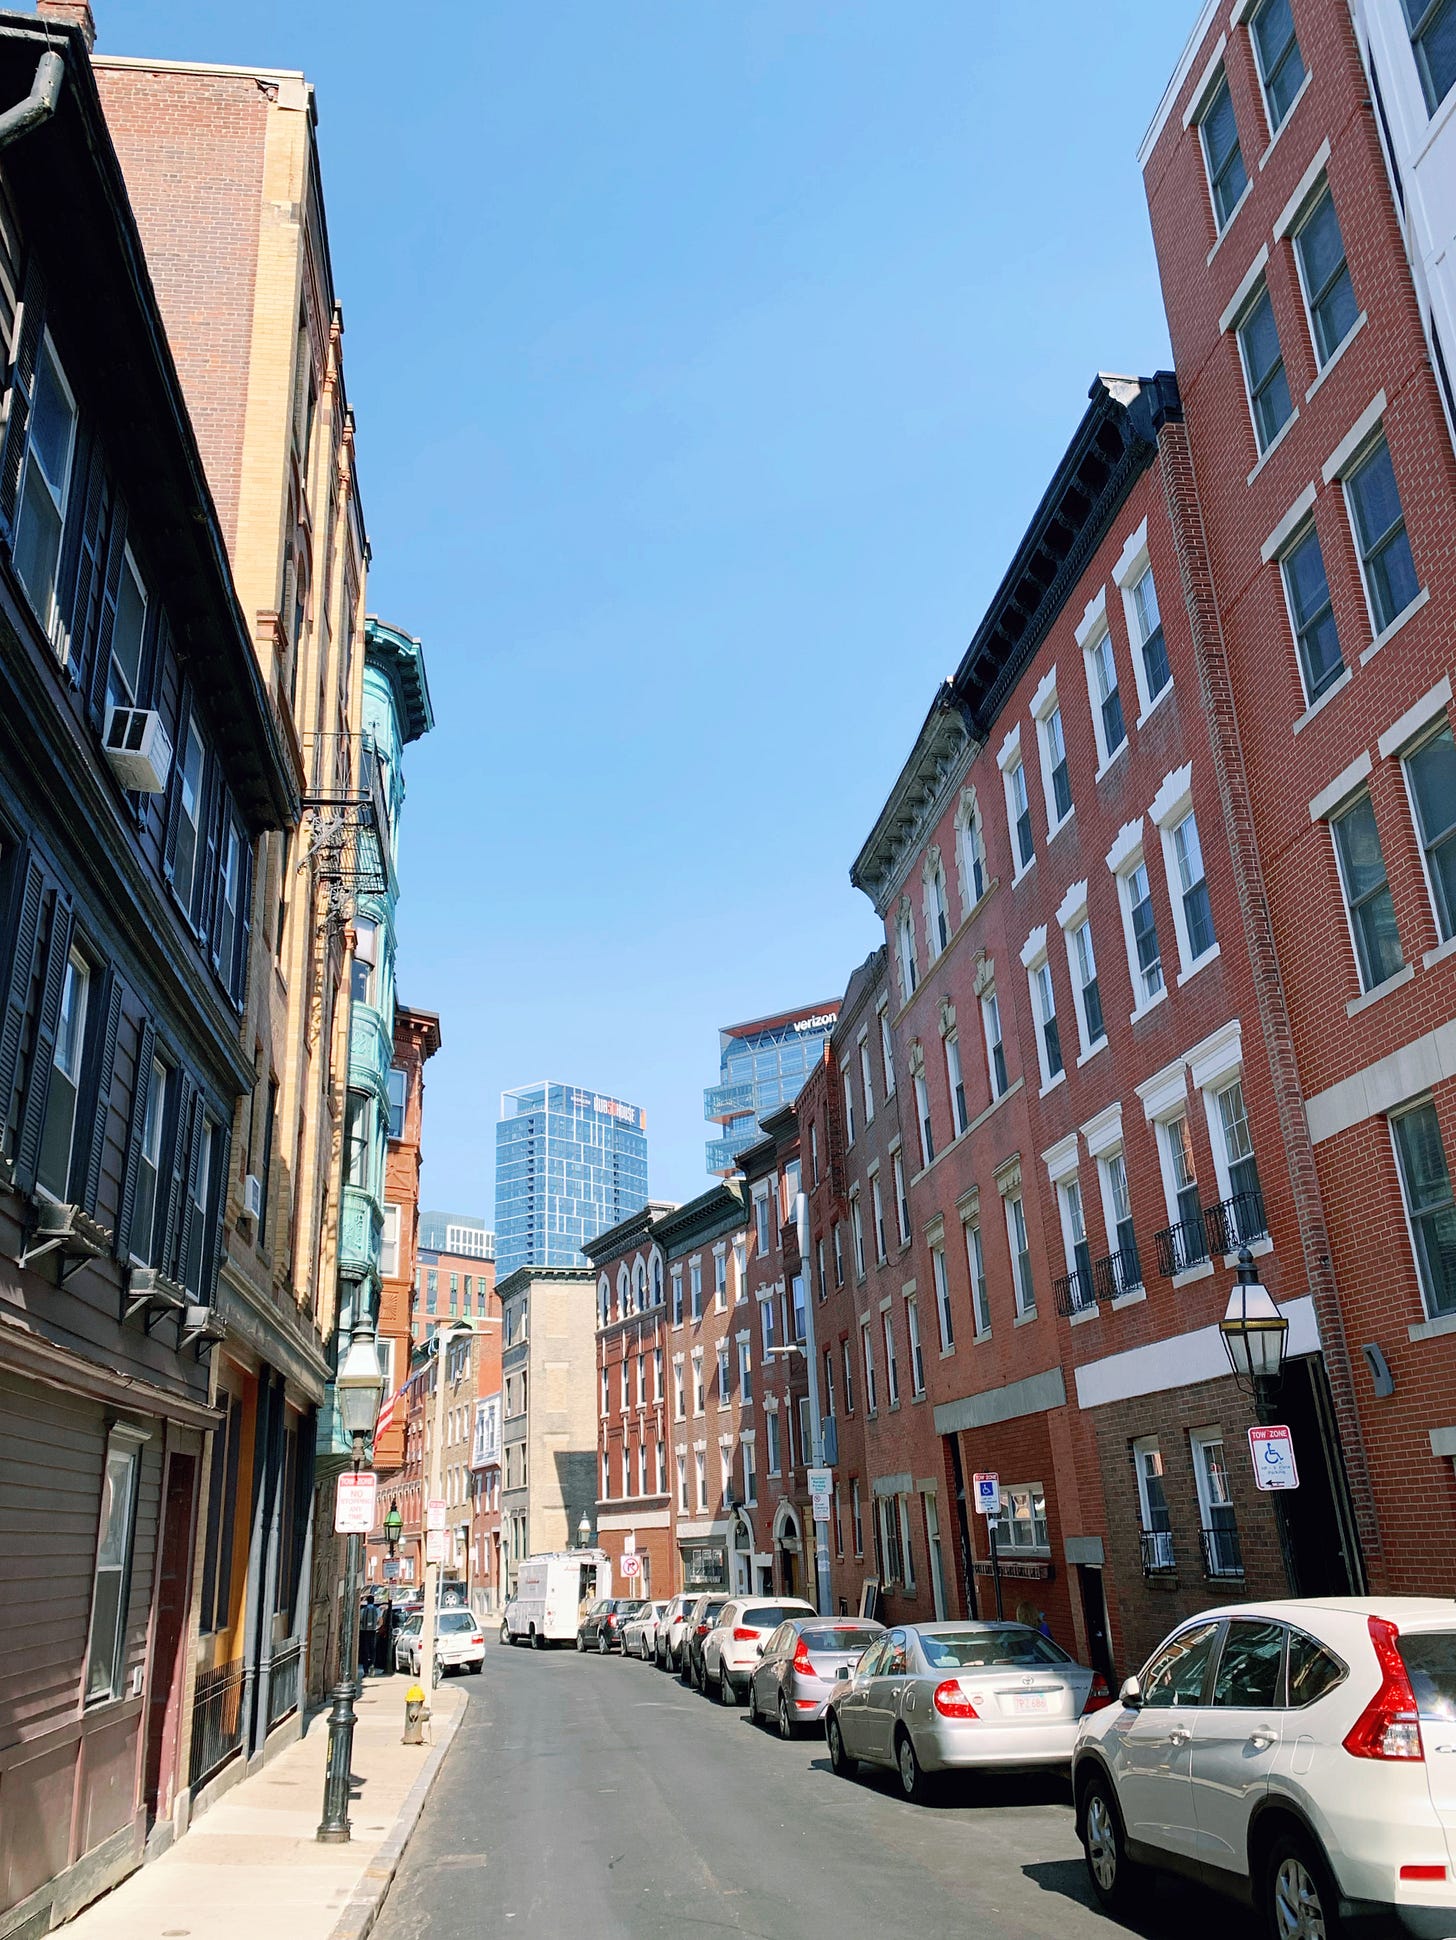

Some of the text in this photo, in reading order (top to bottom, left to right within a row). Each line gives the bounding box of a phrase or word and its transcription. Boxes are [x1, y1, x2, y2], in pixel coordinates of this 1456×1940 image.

[793, 1012, 837, 1032] verizon
[1252, 1429, 1288, 1439] TOW ZONE
